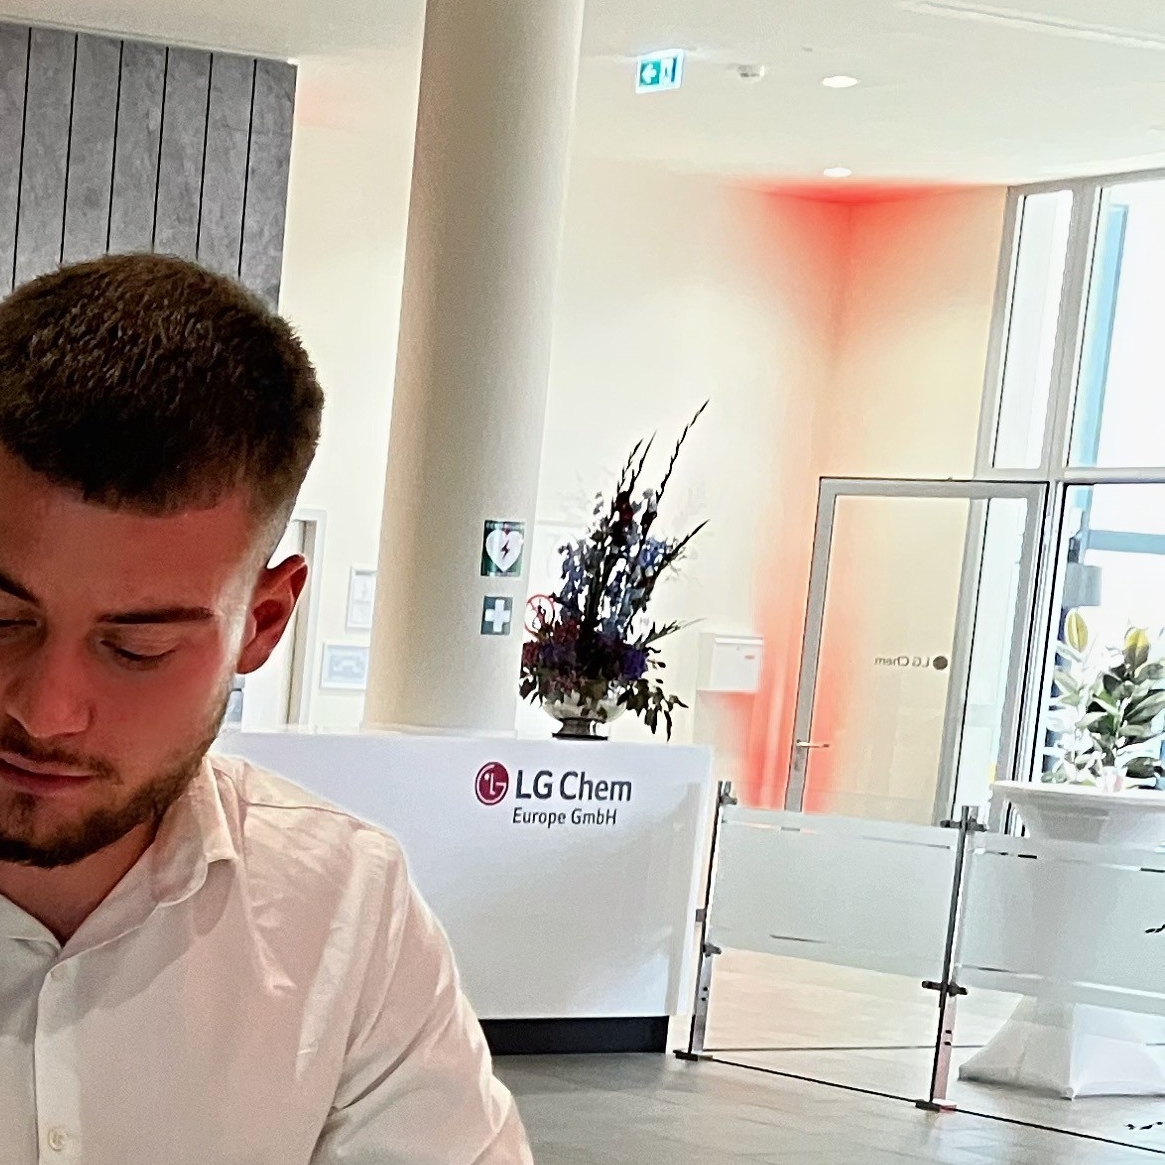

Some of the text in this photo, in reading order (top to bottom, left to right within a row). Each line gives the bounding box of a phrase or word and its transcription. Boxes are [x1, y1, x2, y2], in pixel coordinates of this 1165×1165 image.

[515, 769, 553, 800] LG
[559, 771, 632, 802] Chem
[512, 806, 617, 828] Europe GmbH
